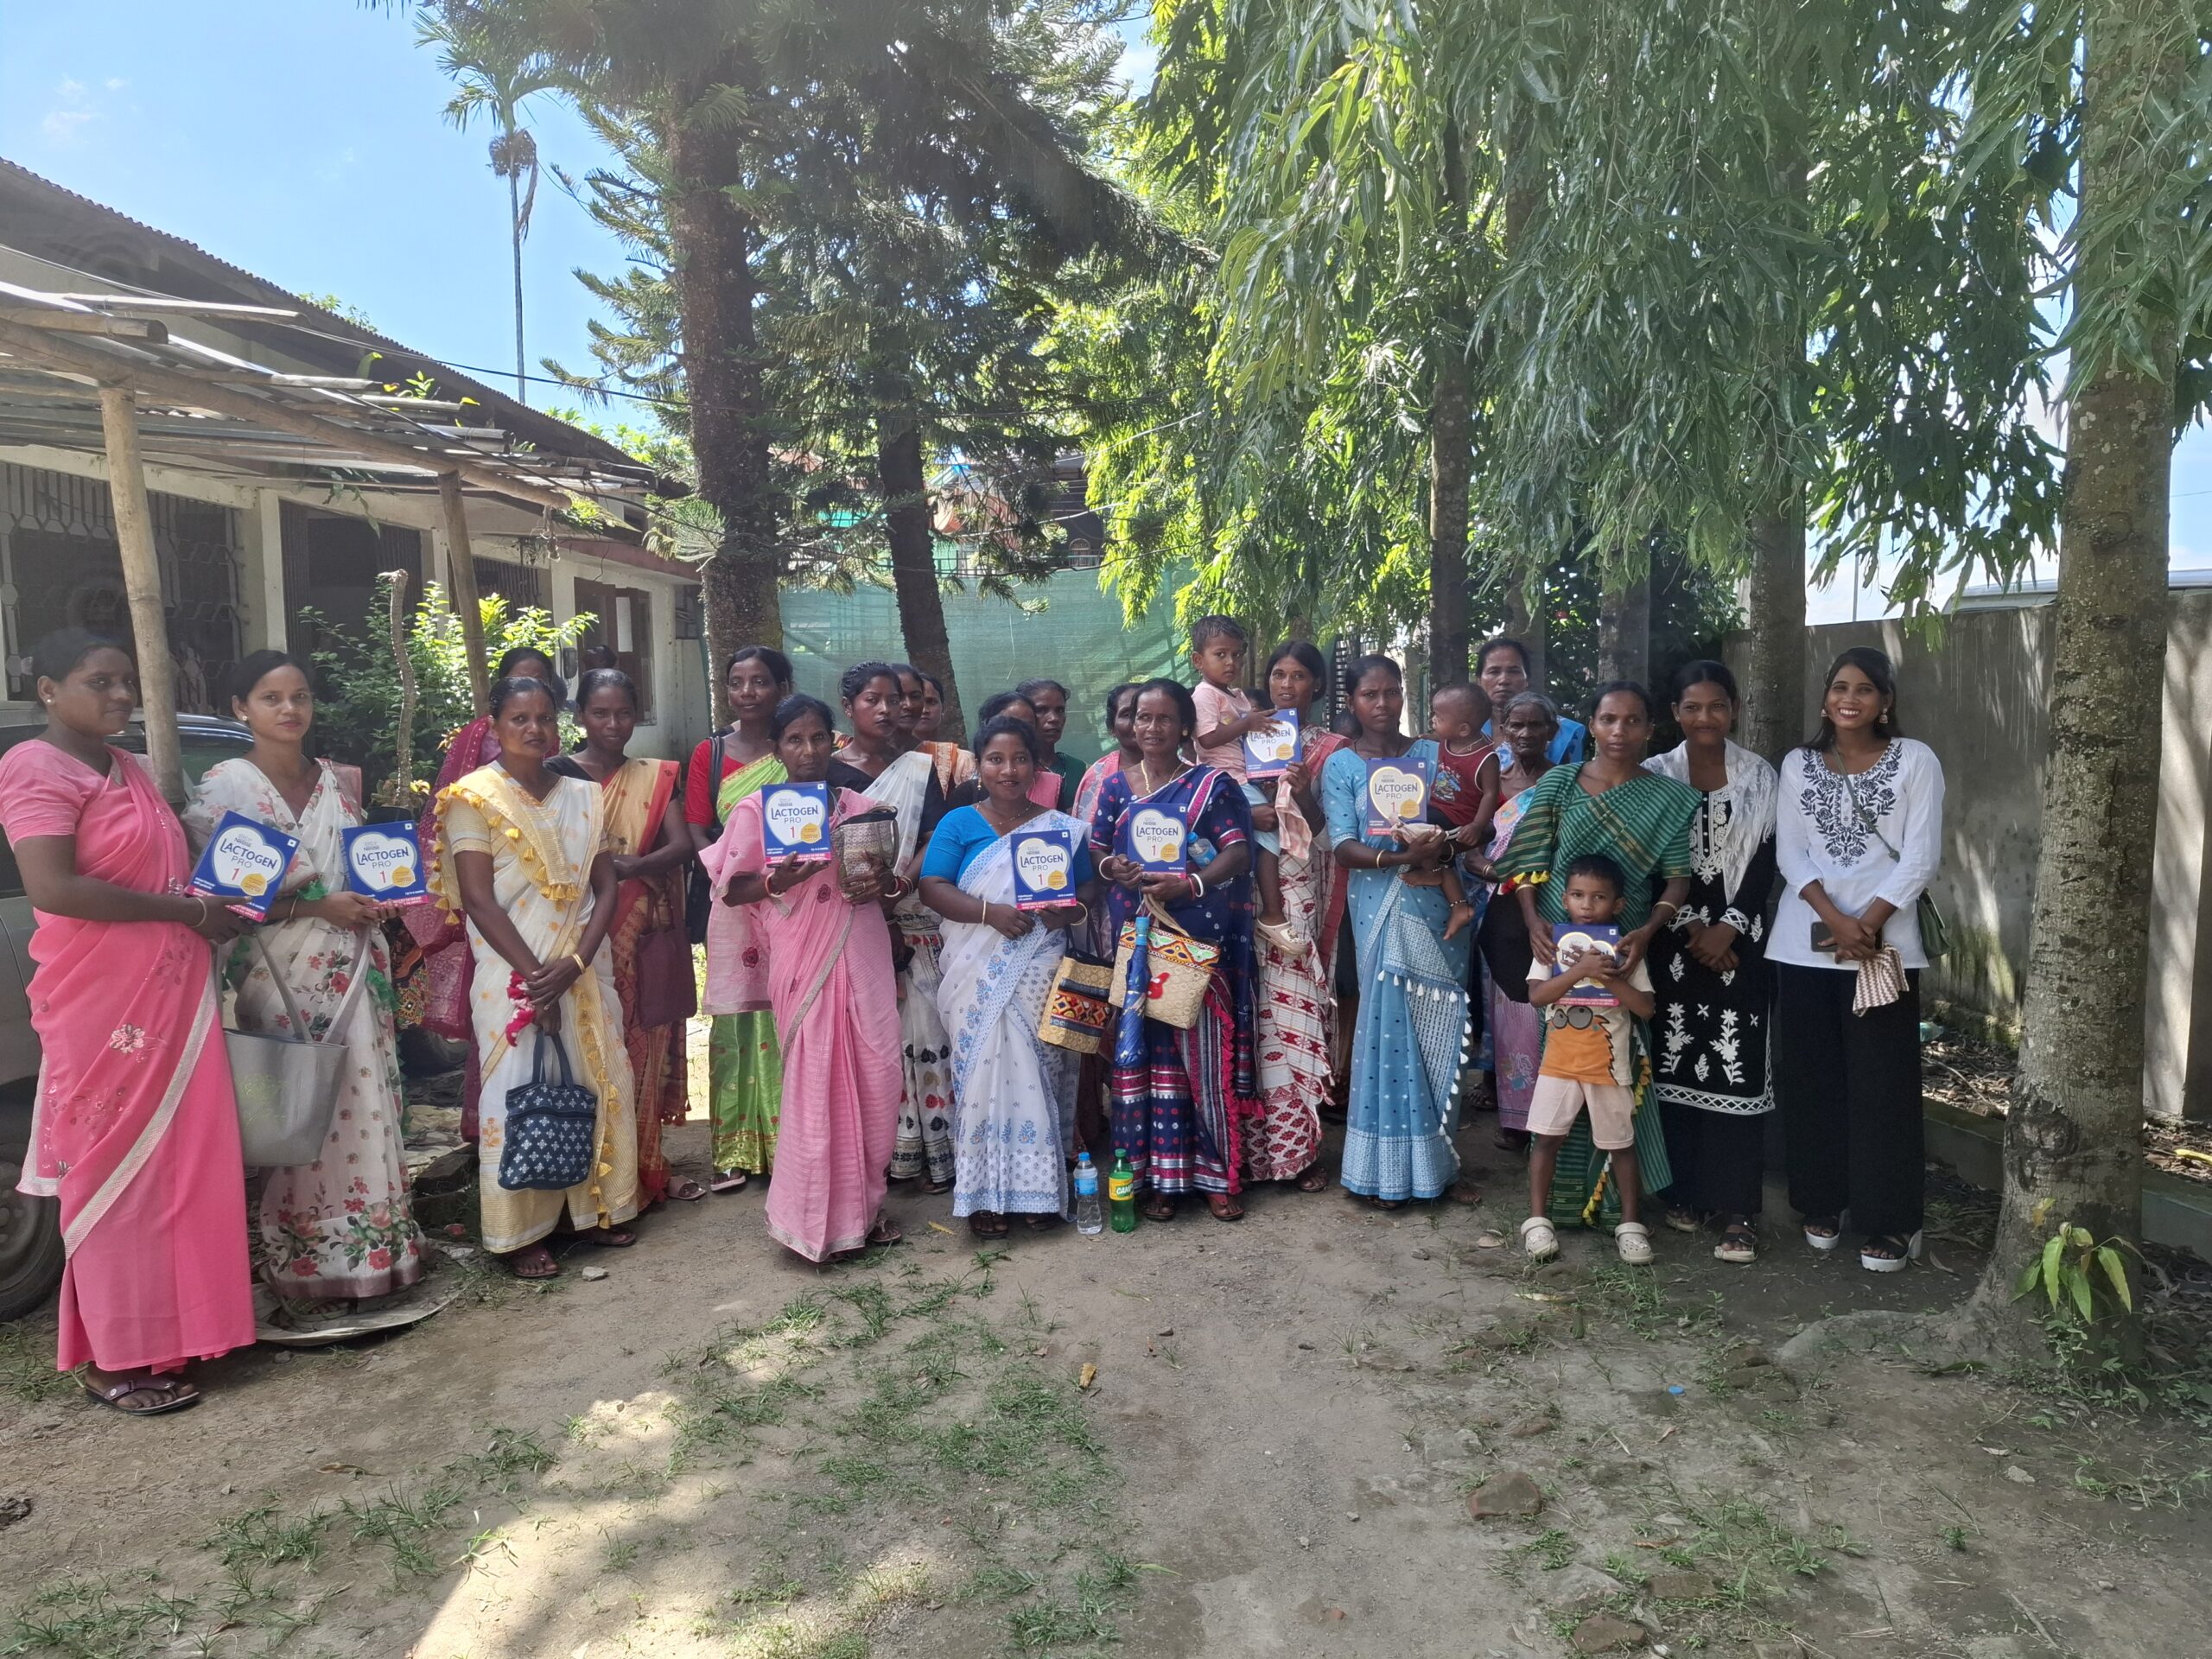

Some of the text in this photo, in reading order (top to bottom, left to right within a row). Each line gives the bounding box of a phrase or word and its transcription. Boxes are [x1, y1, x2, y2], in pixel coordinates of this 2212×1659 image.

[1375, 783, 1418, 795] LACTOGEN
[771, 804, 819, 820] LACTOGEN
[1390, 802, 1395, 813] 1
[790, 826, 795, 838] 1
[1136, 825, 1179, 837] LACTOGEN
[219, 838, 277, 869] LACTOGEN
[356, 846, 410, 866] LACTOGEN
[1152, 844, 1156, 856] 1
[231, 855, 252, 868] PRO
[1020, 852, 1064, 868] LACTOGEN
[232, 868, 239, 880] 1
[380, 870, 386, 883] 1
[1038, 874, 1043, 885] 1
